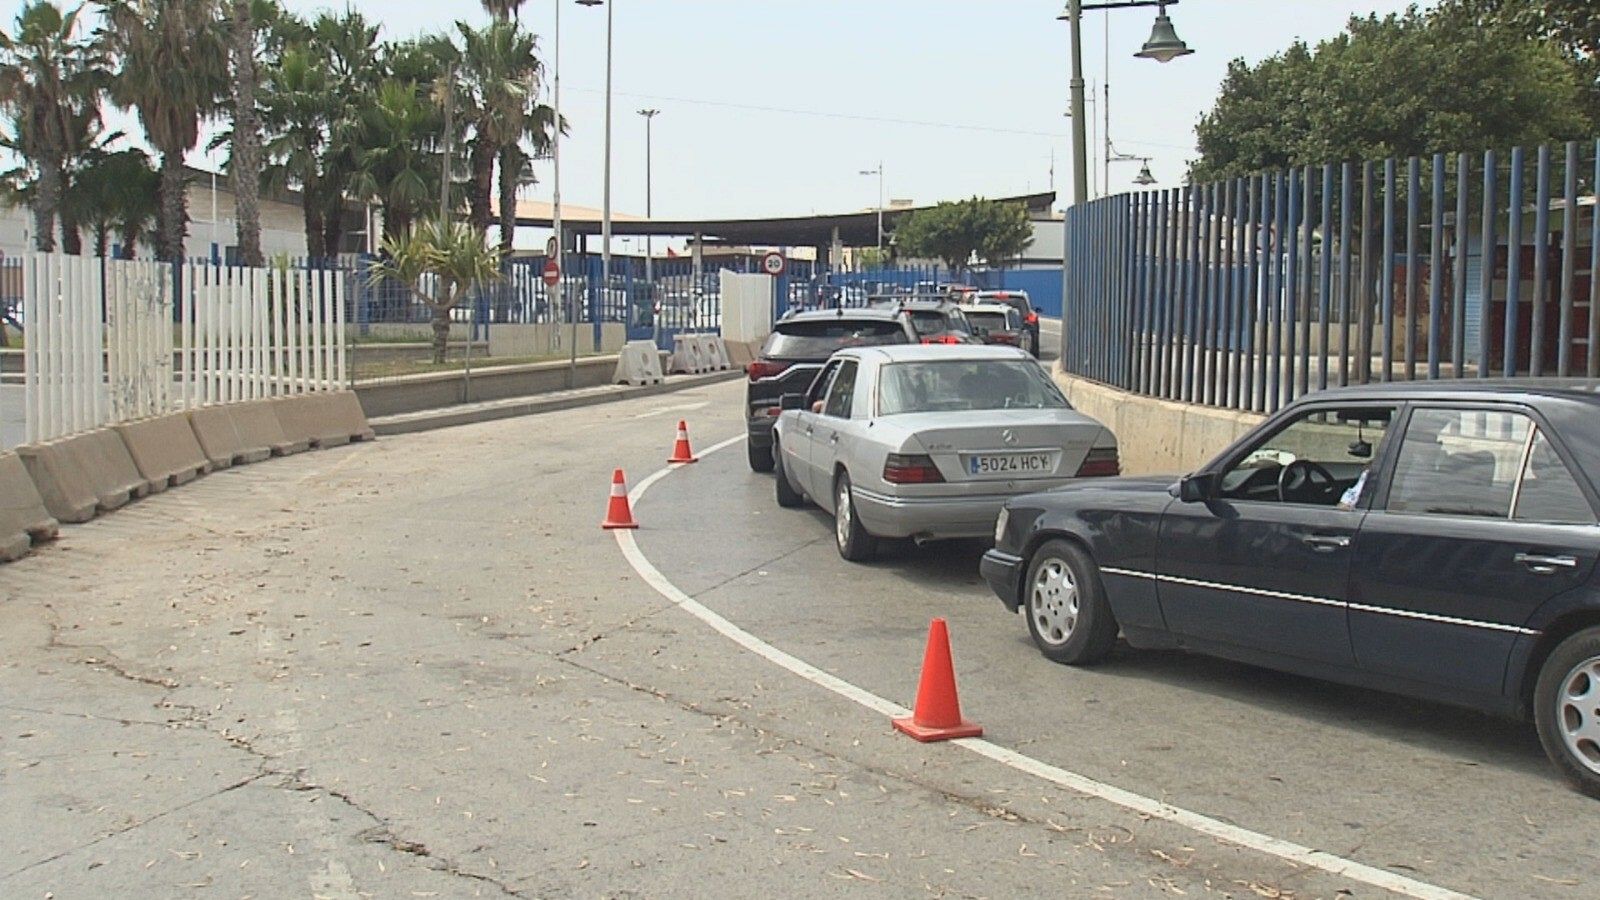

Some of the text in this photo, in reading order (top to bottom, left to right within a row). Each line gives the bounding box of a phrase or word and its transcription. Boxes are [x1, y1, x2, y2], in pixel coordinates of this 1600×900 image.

[768, 259, 780, 268] 20
[980, 456, 1047, 471] 5024 HCY
